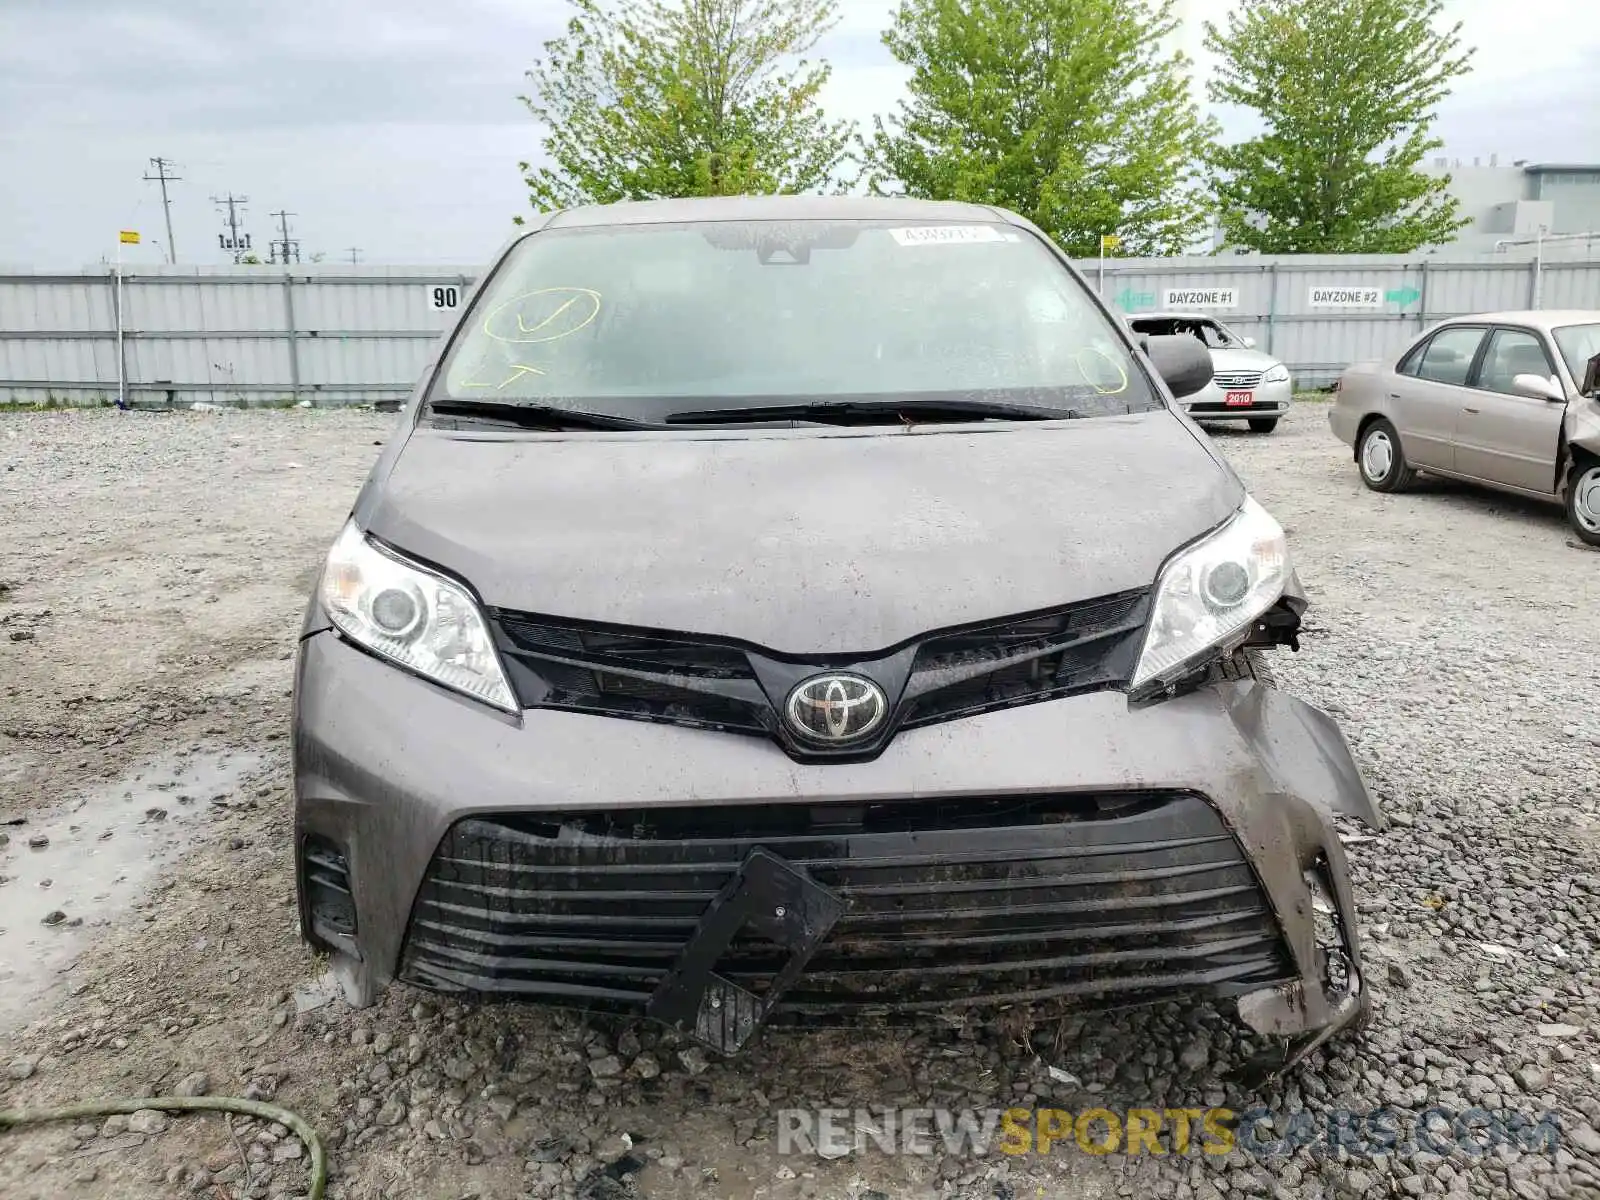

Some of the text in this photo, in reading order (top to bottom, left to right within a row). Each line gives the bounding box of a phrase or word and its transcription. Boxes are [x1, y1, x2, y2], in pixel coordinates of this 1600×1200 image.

[433, 287, 457, 308] 90
[1168, 291, 1233, 304] DAYZONE #1
[1313, 290, 1378, 303] DAYZONE #2
[1228, 393, 1250, 403] 2010
